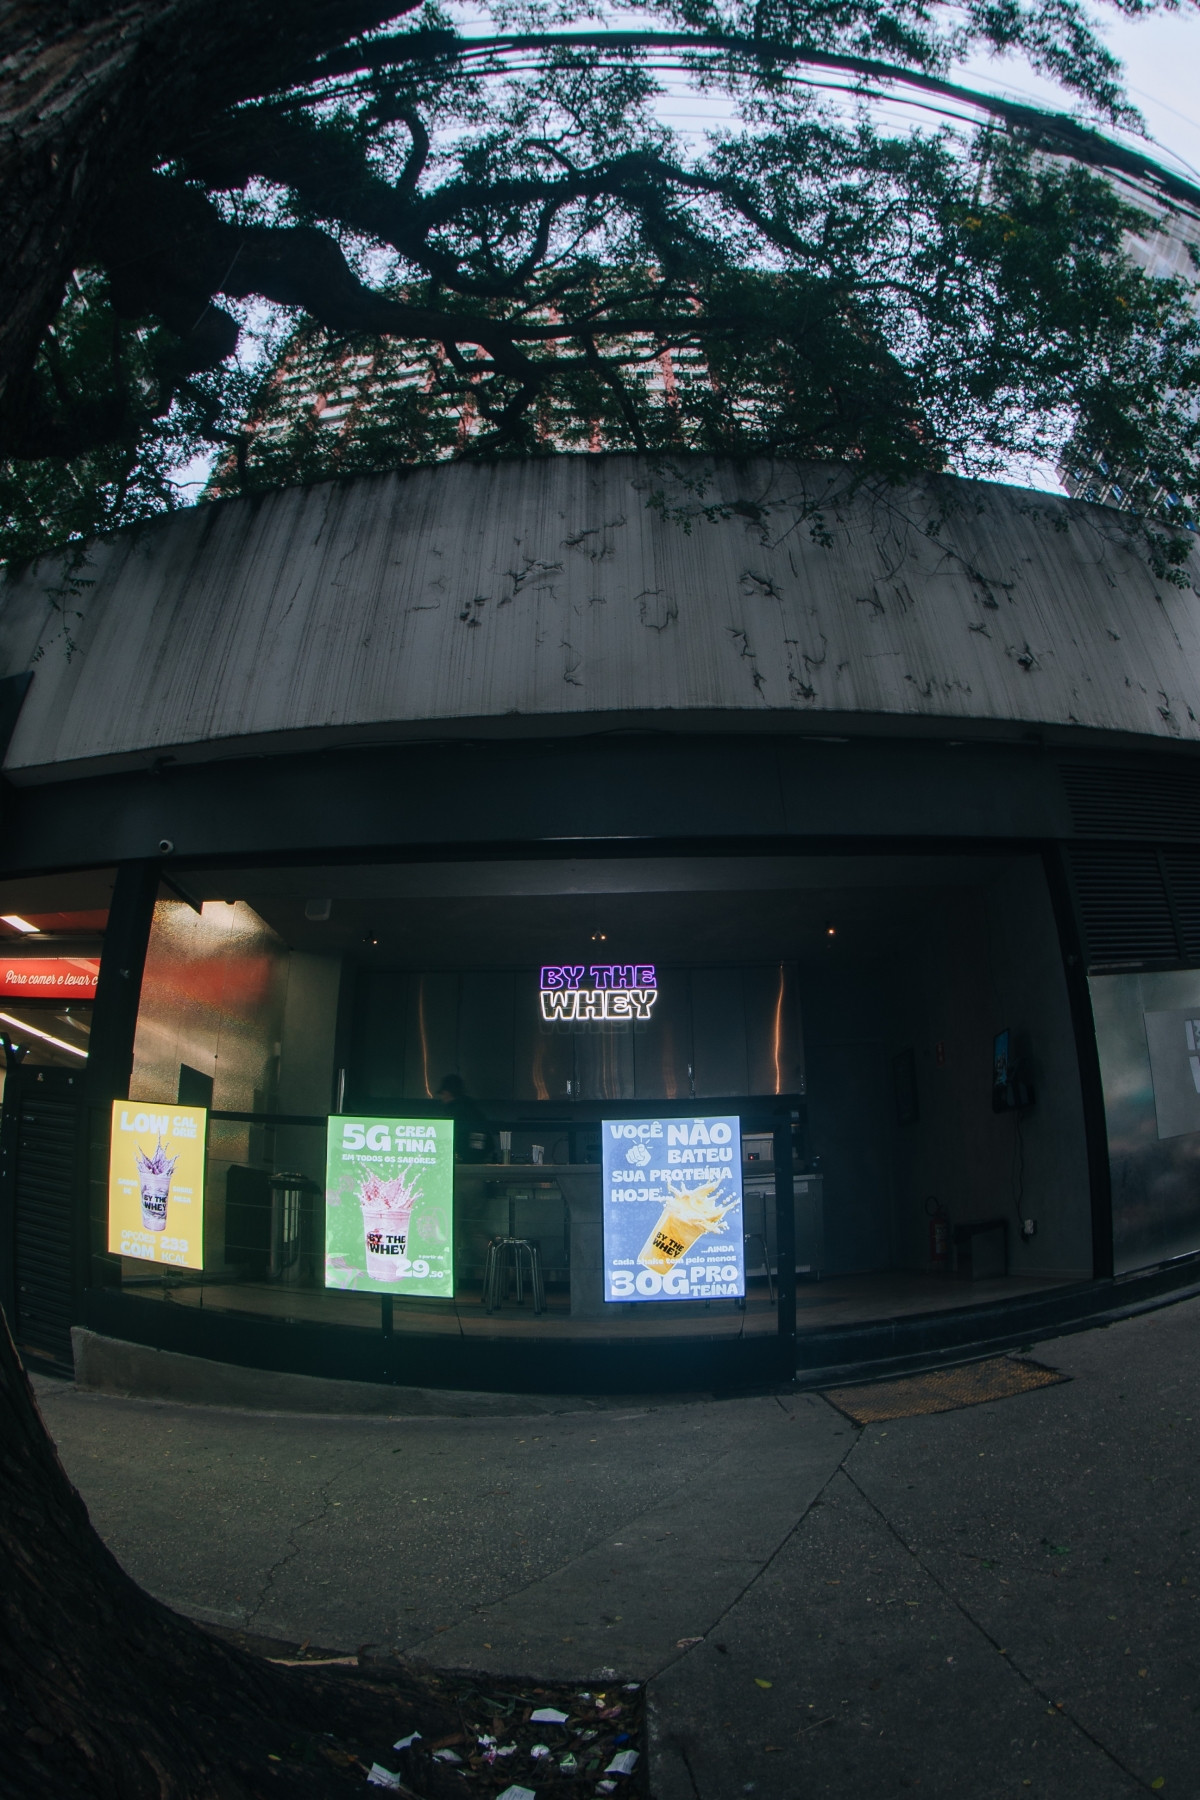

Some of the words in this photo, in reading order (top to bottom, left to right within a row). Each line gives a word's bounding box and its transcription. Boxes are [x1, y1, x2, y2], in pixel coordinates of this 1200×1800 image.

[5, 970, 28, 984] Para
[28, 974, 56, 985] comer
[57, 975, 64, 985] e
[64, 973, 91, 985] levar
[541, 966, 585, 989] BY
[590, 965, 657, 989] THE
[540, 990, 658, 1020] WHEY
[120, 1111, 169, 1135] LOW
[173, 1116, 197, 1128] CAL
[172, 1127, 197, 1138] ORIE
[342, 1123, 392, 1152] 5G
[395, 1125, 437, 1138] CREA
[610, 1121, 664, 1139] VOCÊ
[667, 1119, 732, 1146] NÃO
[395, 1139, 437, 1153] TINA
[342, 1153, 354, 1161] EM
[356, 1154, 383, 1163] TODOS
[397, 1156, 437, 1164] SABORES
[667, 1148, 733, 1164] BATEU
[612, 1170, 646, 1182] SUA
[649, 1165, 733, 1182] PROTEÍNA
[144, 1194, 153, 1202] BY
[155, 1196, 167, 1204] THE
[144, 1201, 167, 1212] WHEY
[160, 1236, 189, 1252] 233
[369, 1233, 383, 1243] BY
[386, 1235, 406, 1244] THE
[657, 1231, 668, 1242] BY
[669, 1239, 684, 1253] THE
[121, 1241, 154, 1260] COM
[369, 1244, 406, 1255] WHEY
[652, 1237, 681, 1258] WHEY
[612, 1258, 635, 1266] cada
[636, 1257, 664, 1265] shake
[666, 1257, 684, 1265] tem
[686, 1256, 705, 1265] pelo
[707, 1255, 737, 1263] menos
[611, 1268, 690, 1297] 30G
[690, 1265, 738, 1283] PRO
[690, 1281, 739, 1297] TEÍNA
